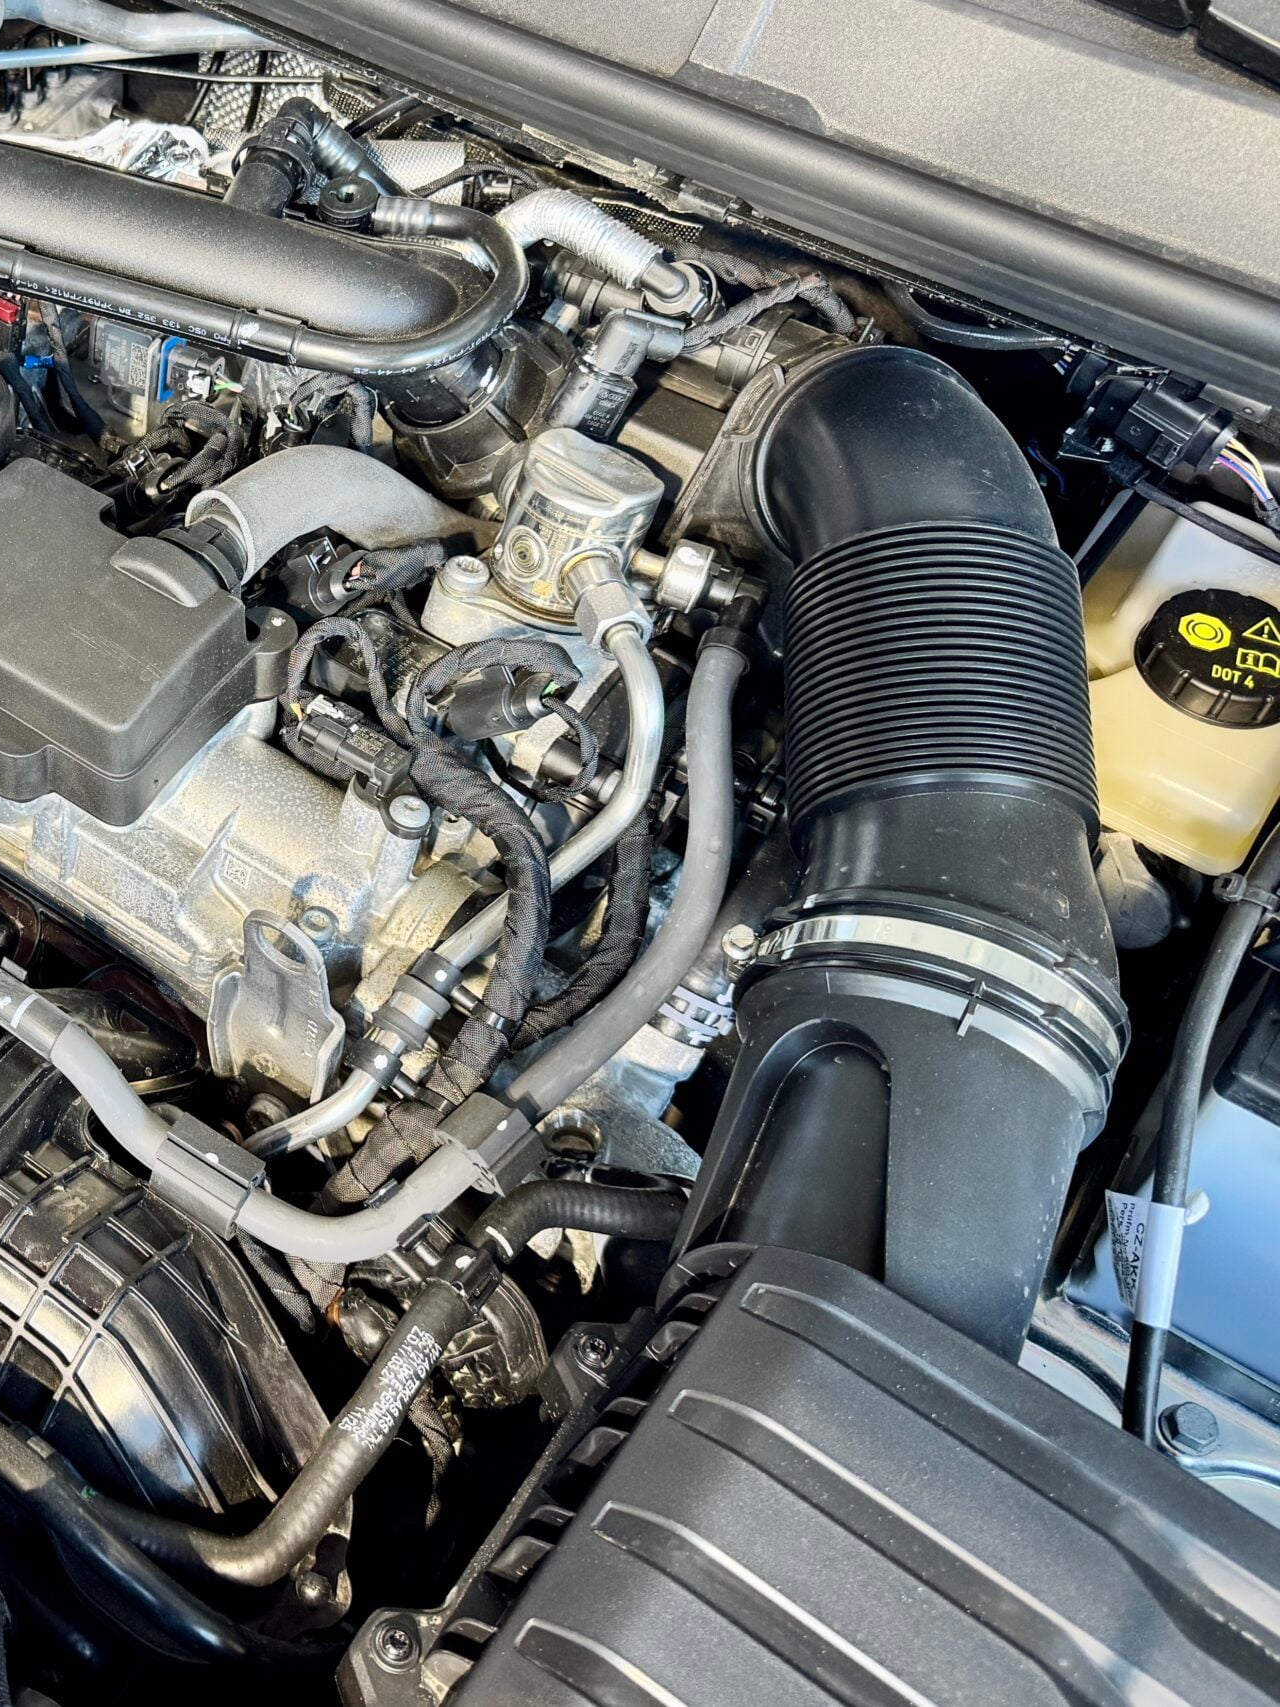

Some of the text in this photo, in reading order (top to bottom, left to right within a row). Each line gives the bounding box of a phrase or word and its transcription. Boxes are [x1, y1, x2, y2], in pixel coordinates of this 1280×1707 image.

[137, 312, 156, 322] 352
[1212, 665, 1254, 688] DOT 4
[415, 1357, 433, 1377] AG
[387, 1374, 419, 1416] TEKLAS
[375, 1411, 394, 1431] RS
